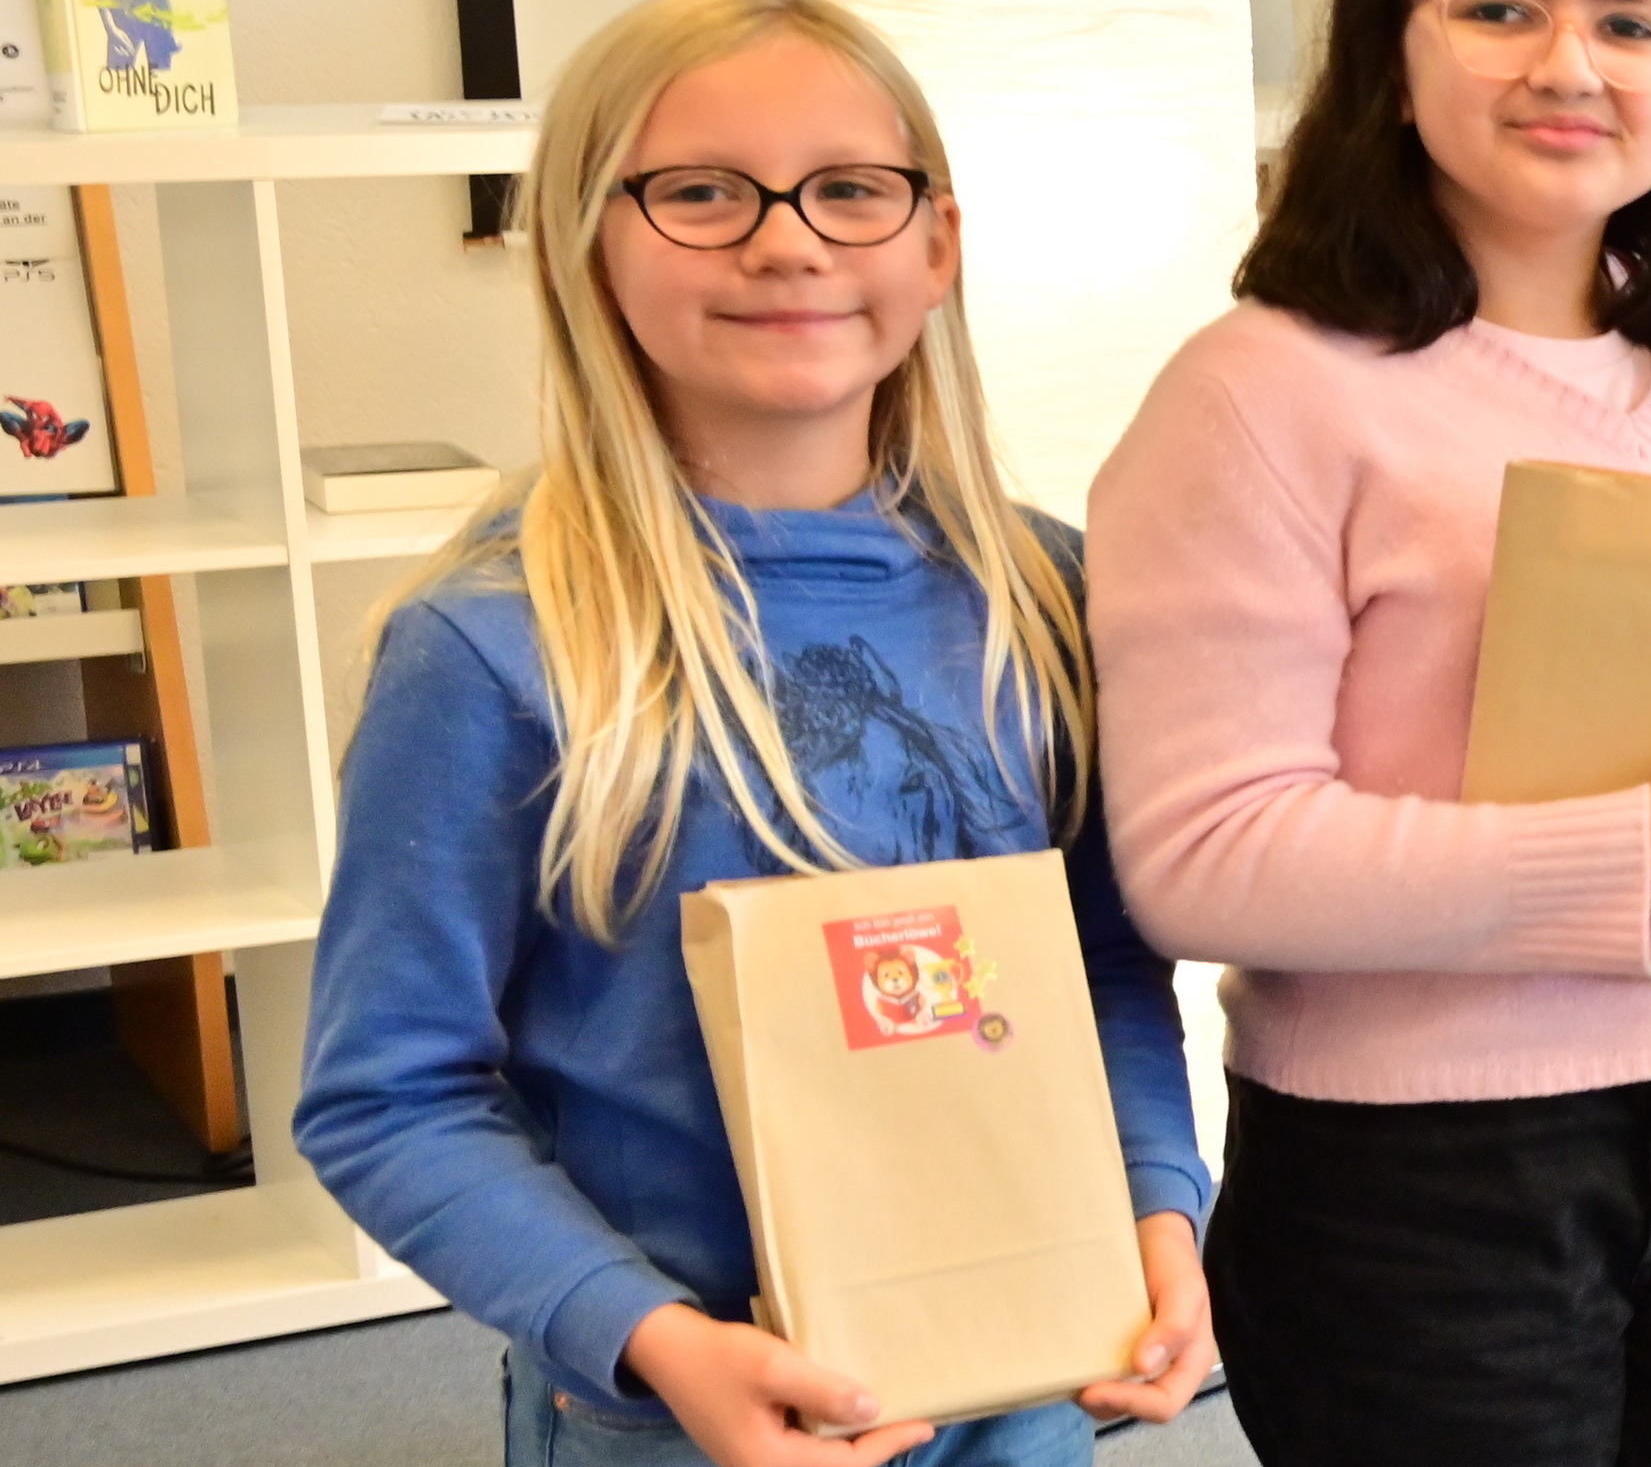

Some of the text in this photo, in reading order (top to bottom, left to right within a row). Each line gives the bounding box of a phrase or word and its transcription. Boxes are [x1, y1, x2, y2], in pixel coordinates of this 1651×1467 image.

[99, 63, 161, 99] OHNE
[155, 81, 216, 116] DICH
[0, 199, 20, 210] äte
[25, 213, 46, 225] der
[4, 269, 56, 281] PS5
